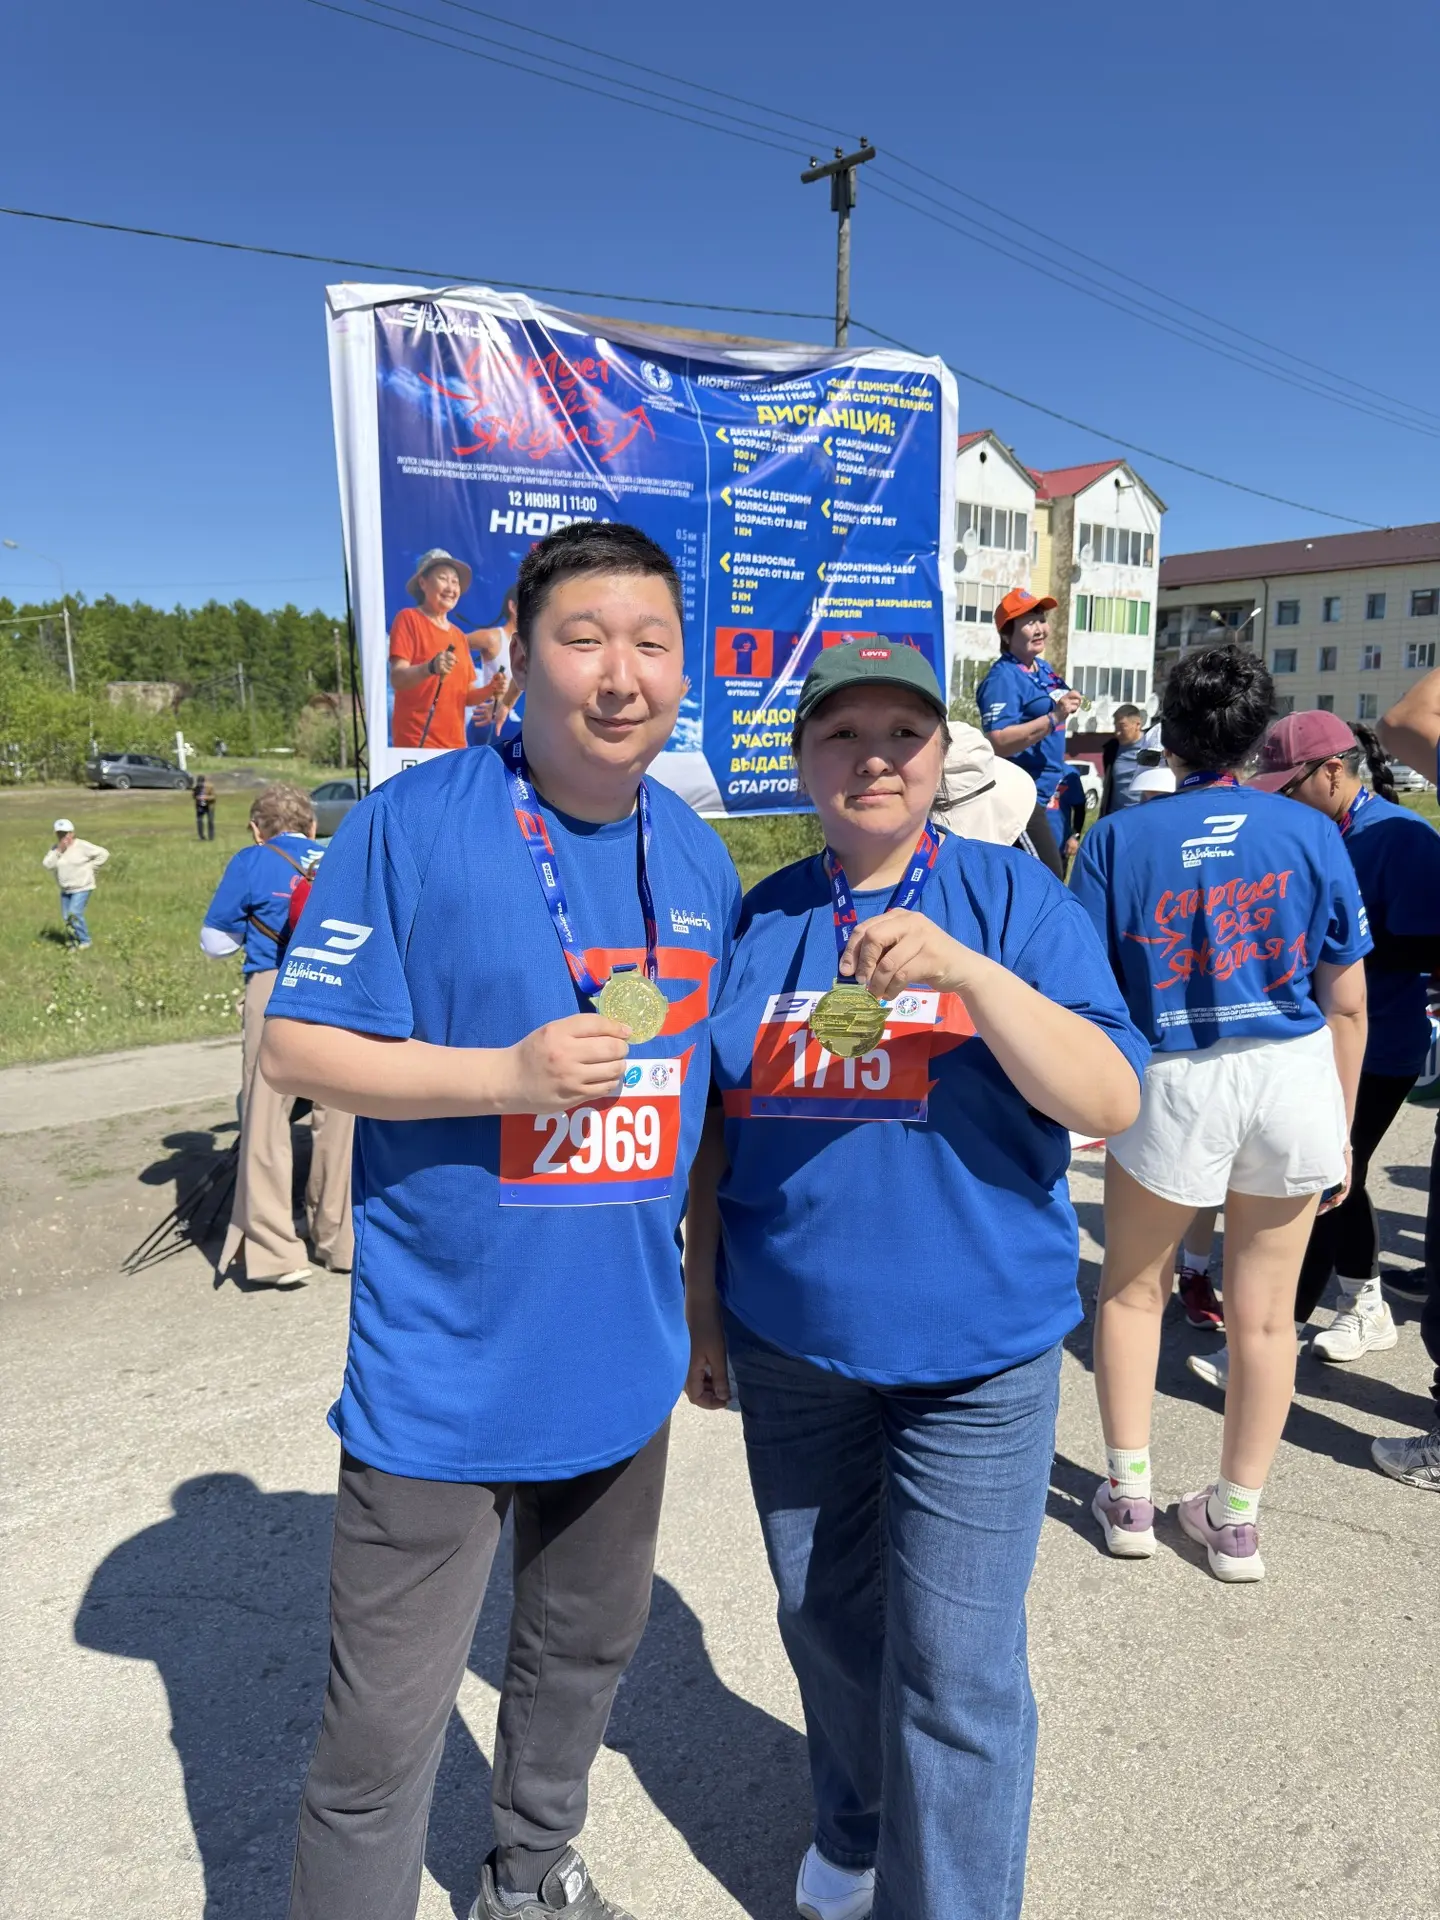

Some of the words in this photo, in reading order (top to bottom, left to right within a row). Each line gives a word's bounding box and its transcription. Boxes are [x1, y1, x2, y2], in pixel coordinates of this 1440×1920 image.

[465, 345, 609, 389] Сртует
[757, 404, 896, 436] ДИСТАНЦИЯ:
[508, 490, 522, 506] 12
[524, 491, 560, 509] ИЮНЯ
[570, 496, 597, 512] 11:00
[735, 500, 786, 514] КОЛЯСКАМИ
[489, 508, 610, 537] НЮР
[793, 520, 807, 530] ЛЕТ
[882, 518, 897, 526] ЛЕТ
[733, 552, 751, 564] ДЛЯ
[752, 553, 796, 567] ВЗРОСЛЫХ
[790, 571, 805, 581] ЛЕТ
[825, 574, 860, 584] ОЗРАСТ:
[860, 575, 871, 584] ОТ
[881, 576, 896, 584] ЛЕТ
[731, 604, 740, 614] 10
[671, 914, 711, 931] ЕДИНСТА
[285, 967, 342, 987] ЕДИНСТВА
[533, 1105, 661, 1174] 2969
